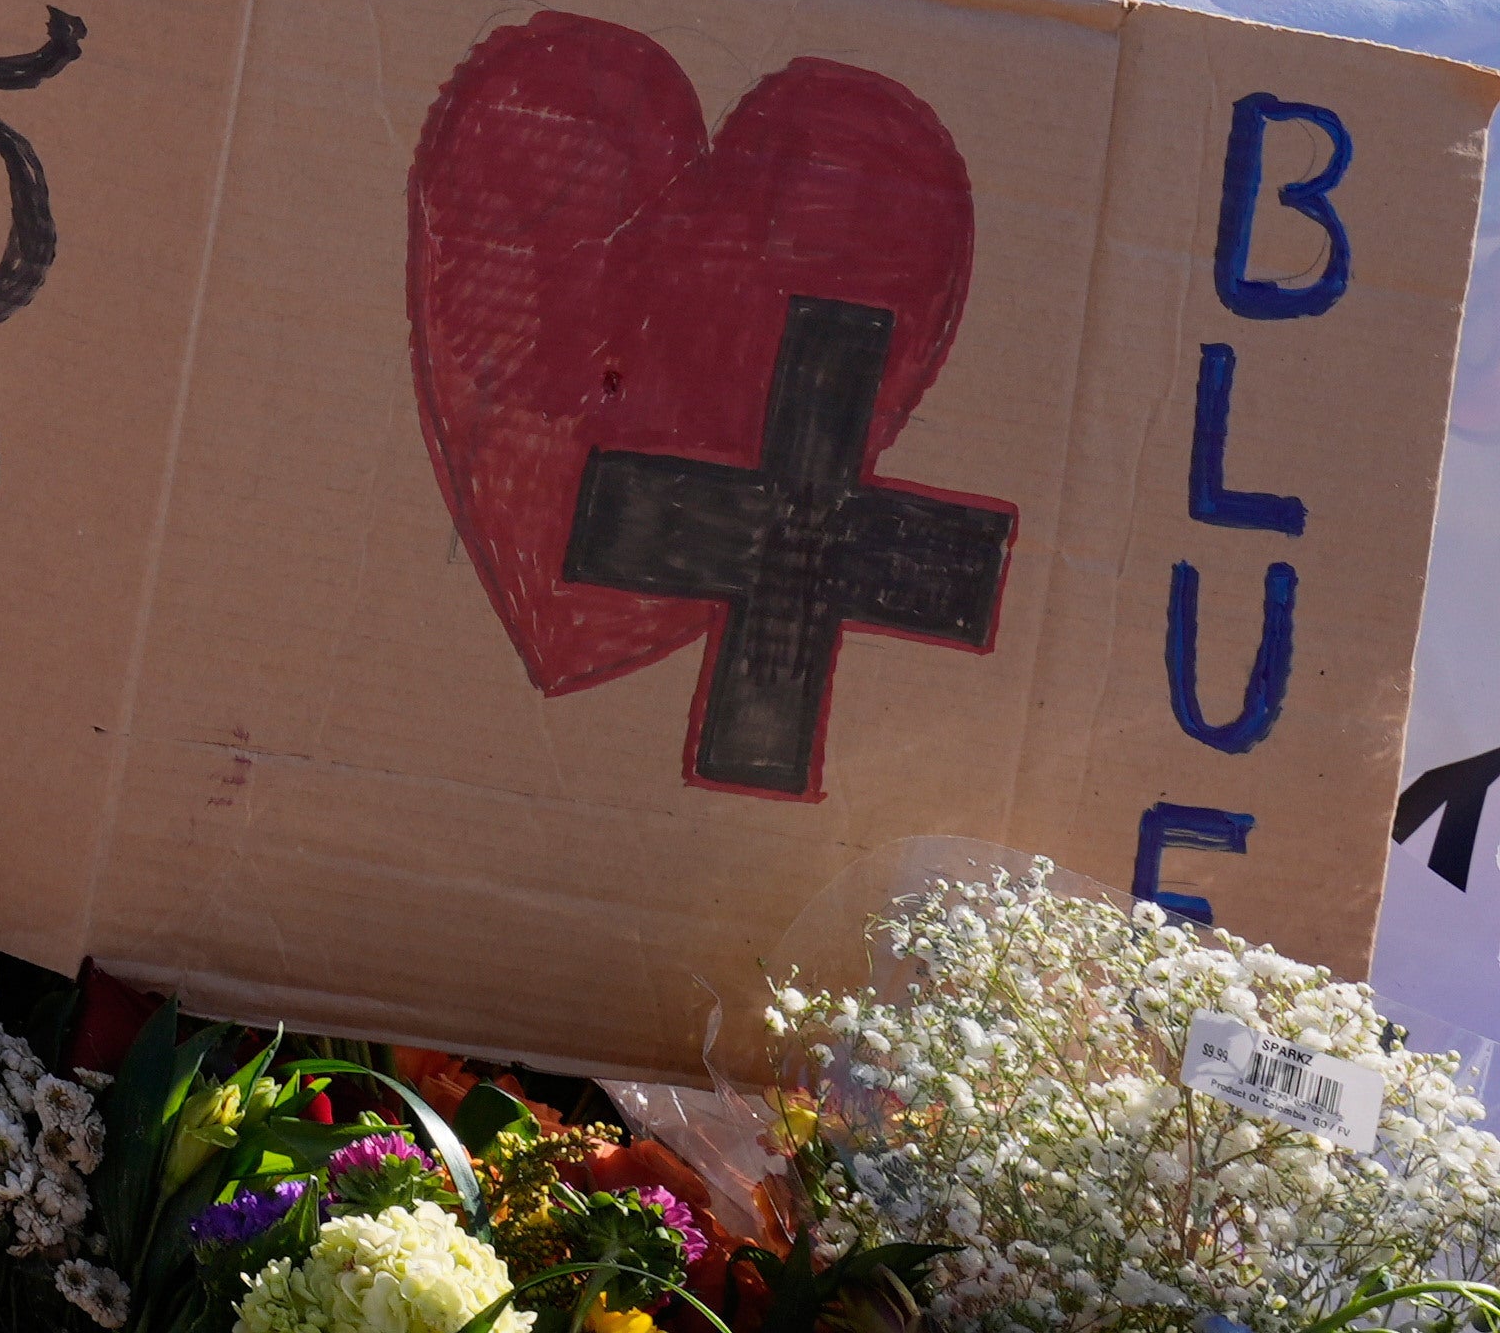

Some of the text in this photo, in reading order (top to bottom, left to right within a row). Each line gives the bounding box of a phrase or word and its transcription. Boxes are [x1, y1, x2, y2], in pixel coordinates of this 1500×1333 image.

[1201, 1038, 1314, 1068] $9.99 SPARKZ
[1210, 1078, 1247, 1101] Product
[1261, 1096, 1308, 1123] Colombia
